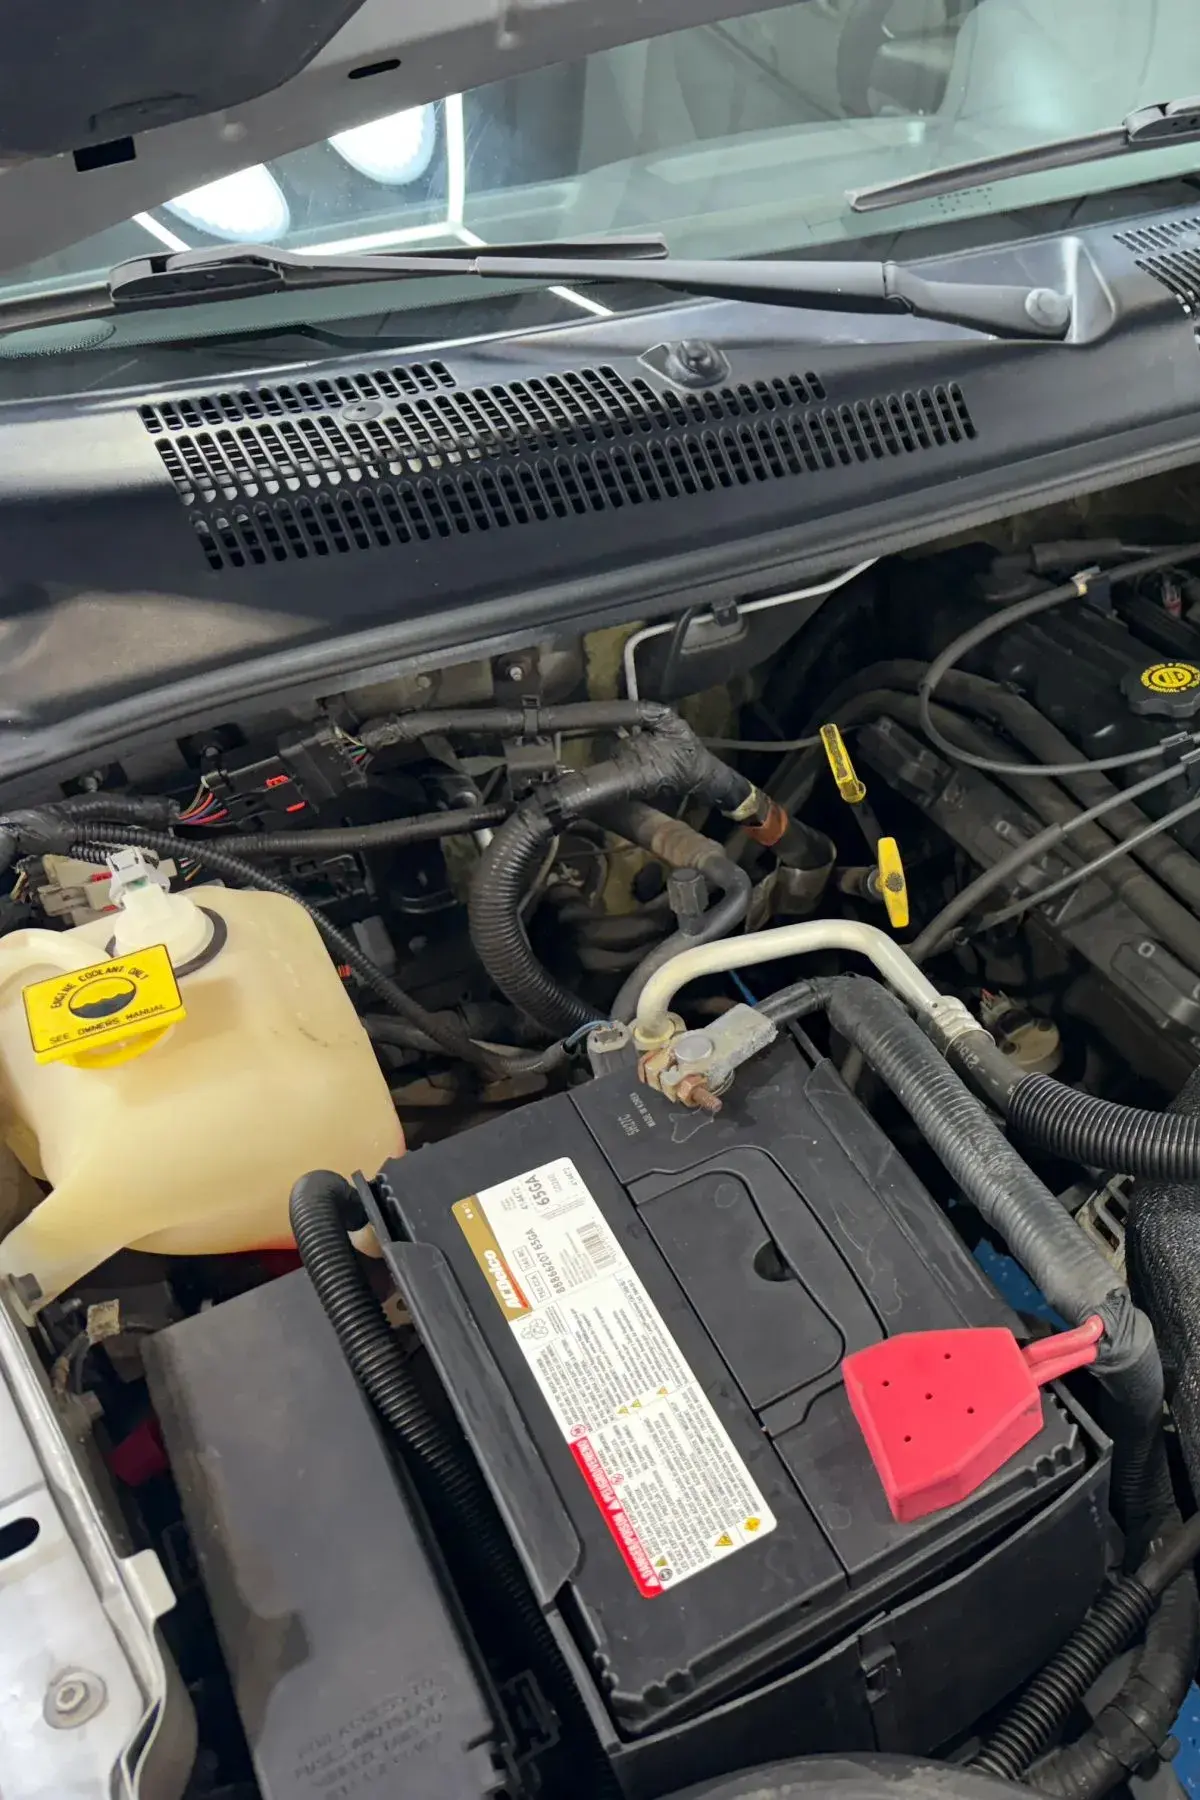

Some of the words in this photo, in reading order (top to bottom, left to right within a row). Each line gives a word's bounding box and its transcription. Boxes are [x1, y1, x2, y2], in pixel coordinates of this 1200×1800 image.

[50, 982, 77, 1010] ENGINE
[77, 965, 125, 983] COOLANT
[49, 1032, 71, 1045] SEE
[77, 1016, 121, 1036] OWNERS
[125, 1003, 167, 1023] MANUAL
[523, 1172, 551, 1208] 65GA
[524, 1227, 545, 1252] 65GA
[483, 1249, 522, 1309] ACDelco
